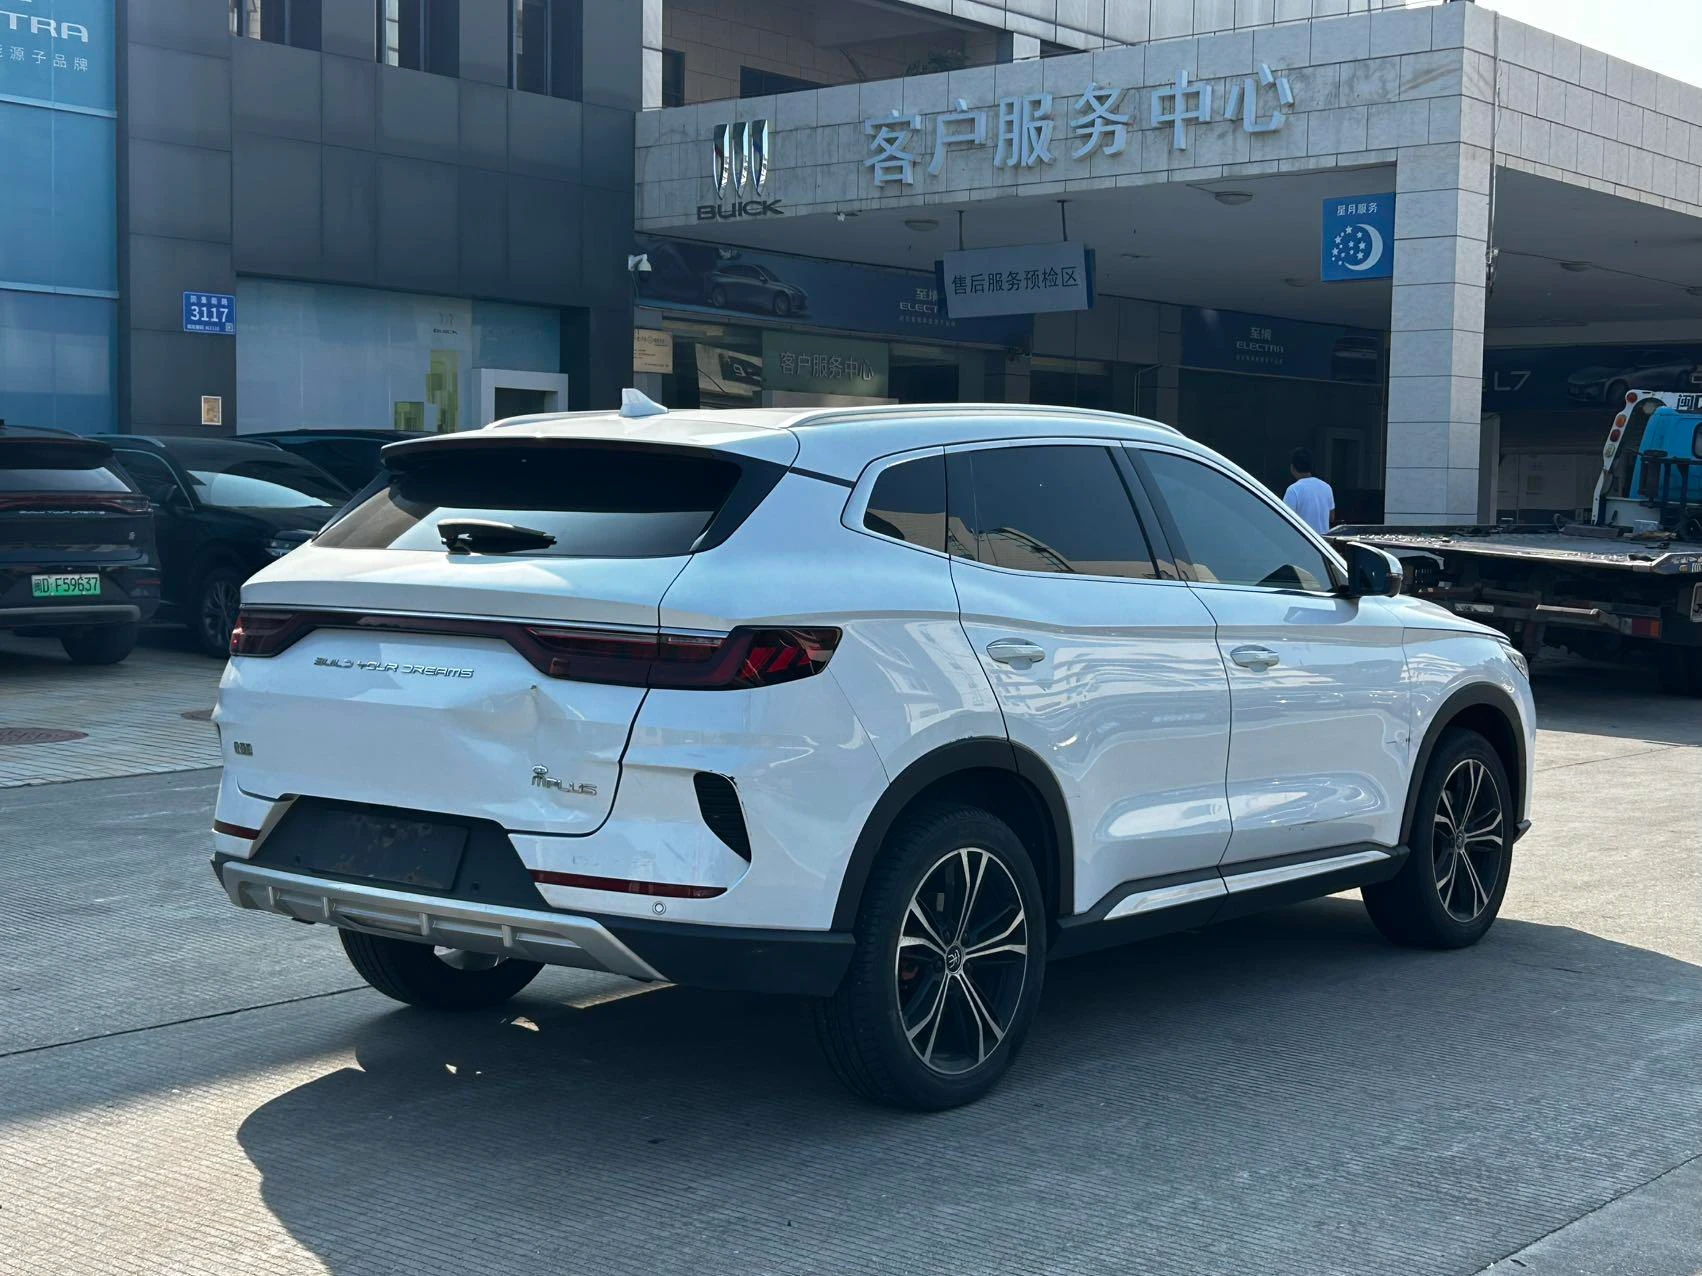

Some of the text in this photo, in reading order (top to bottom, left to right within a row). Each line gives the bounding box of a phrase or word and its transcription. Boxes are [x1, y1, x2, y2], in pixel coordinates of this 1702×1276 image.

[0, 10, 89, 43] TRA
[0, 44, 88, 73] 源子品牌
[864, 63, 1295, 187] 客户服务中心
[697, 199, 784, 221] BUICK
[951, 266, 1079, 296] 售后服务预检区
[190, 305, 229, 323] 3117
[899, 301, 938, 314] ELECT
[779, 352, 875, 381] 客户服务中心
[401, 664, 475, 679] DREAMS
